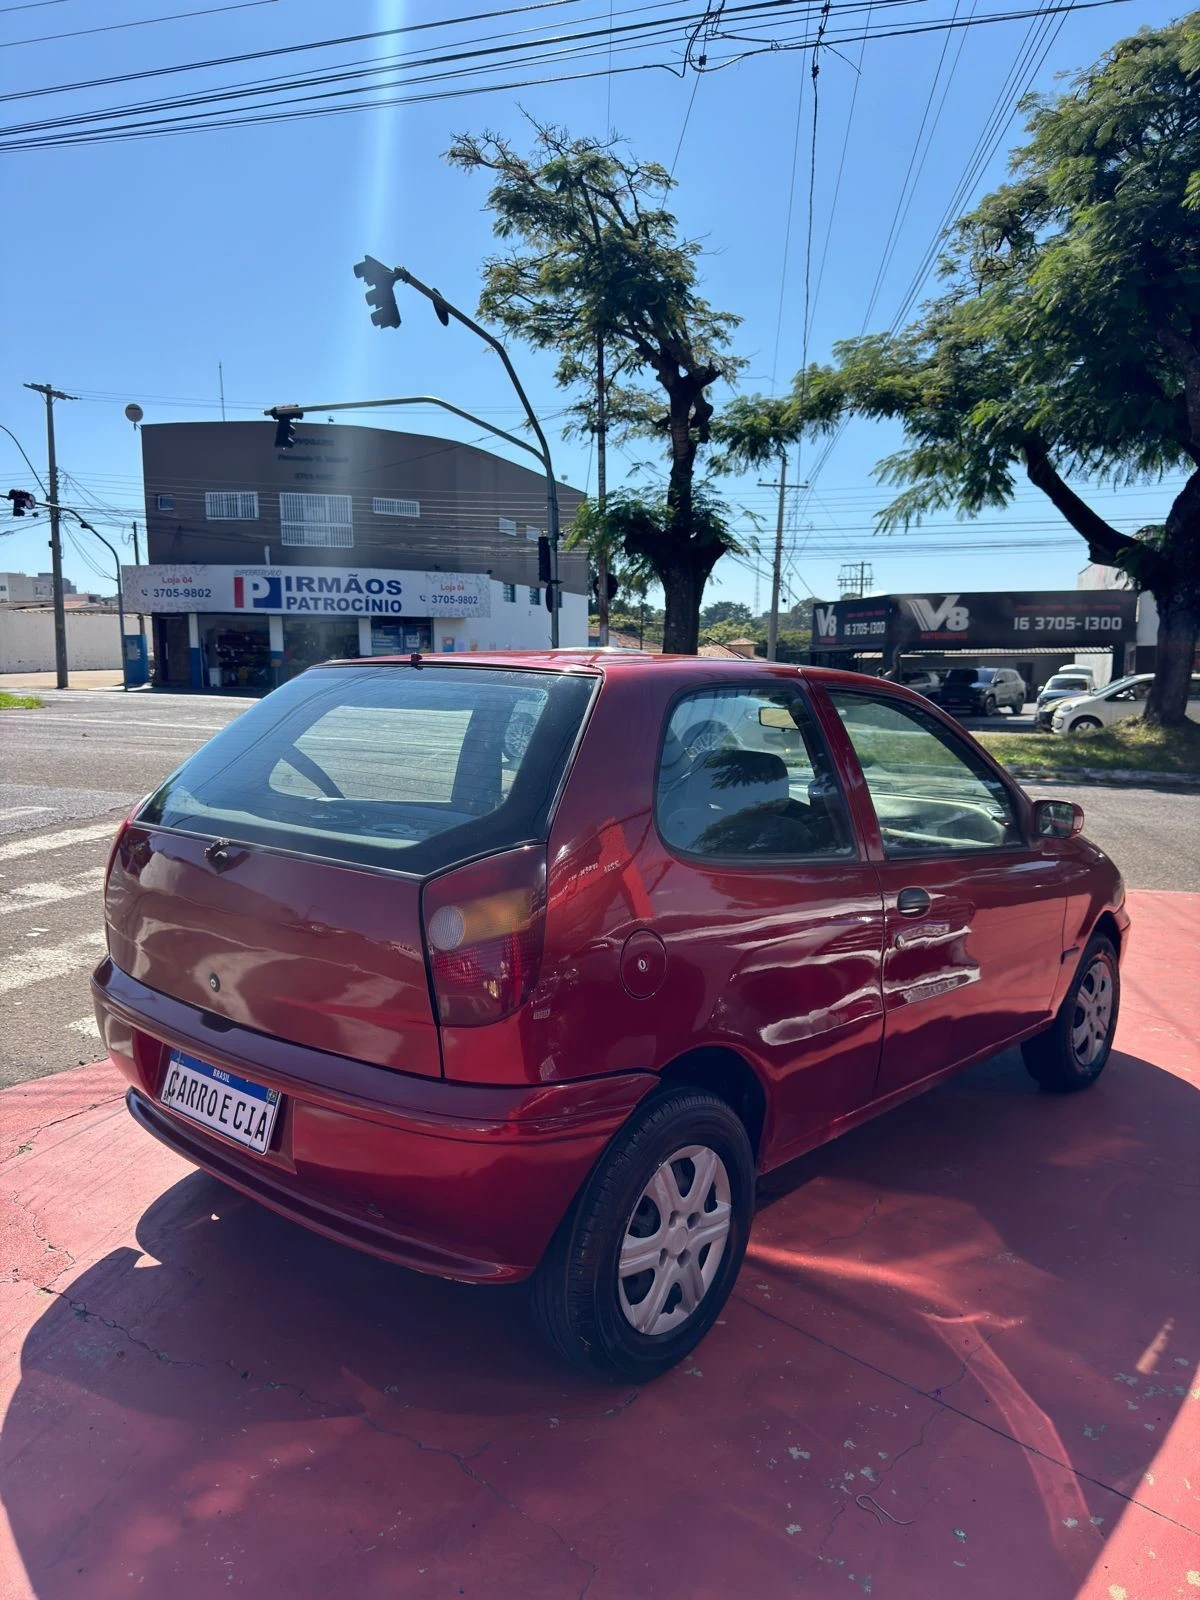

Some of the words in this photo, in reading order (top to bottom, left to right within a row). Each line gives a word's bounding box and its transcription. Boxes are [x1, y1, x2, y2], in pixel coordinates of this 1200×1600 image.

[162, 576, 180, 585] Loja
[285, 574, 402, 596] IRMÃOS
[153, 588, 212, 598] 3705-9802
[431, 595, 478, 604] 3705-9802
[286, 596, 402, 613] PATROCÍNIO
[906, 594, 969, 631] V8
[816, 604, 837, 637] V8
[1014, 616, 1030, 630] 16
[1034, 616, 1123, 630] 3705-1300
[851, 621, 886, 635] 3705-1300
[212, 1068, 230, 1083] BRASIL
